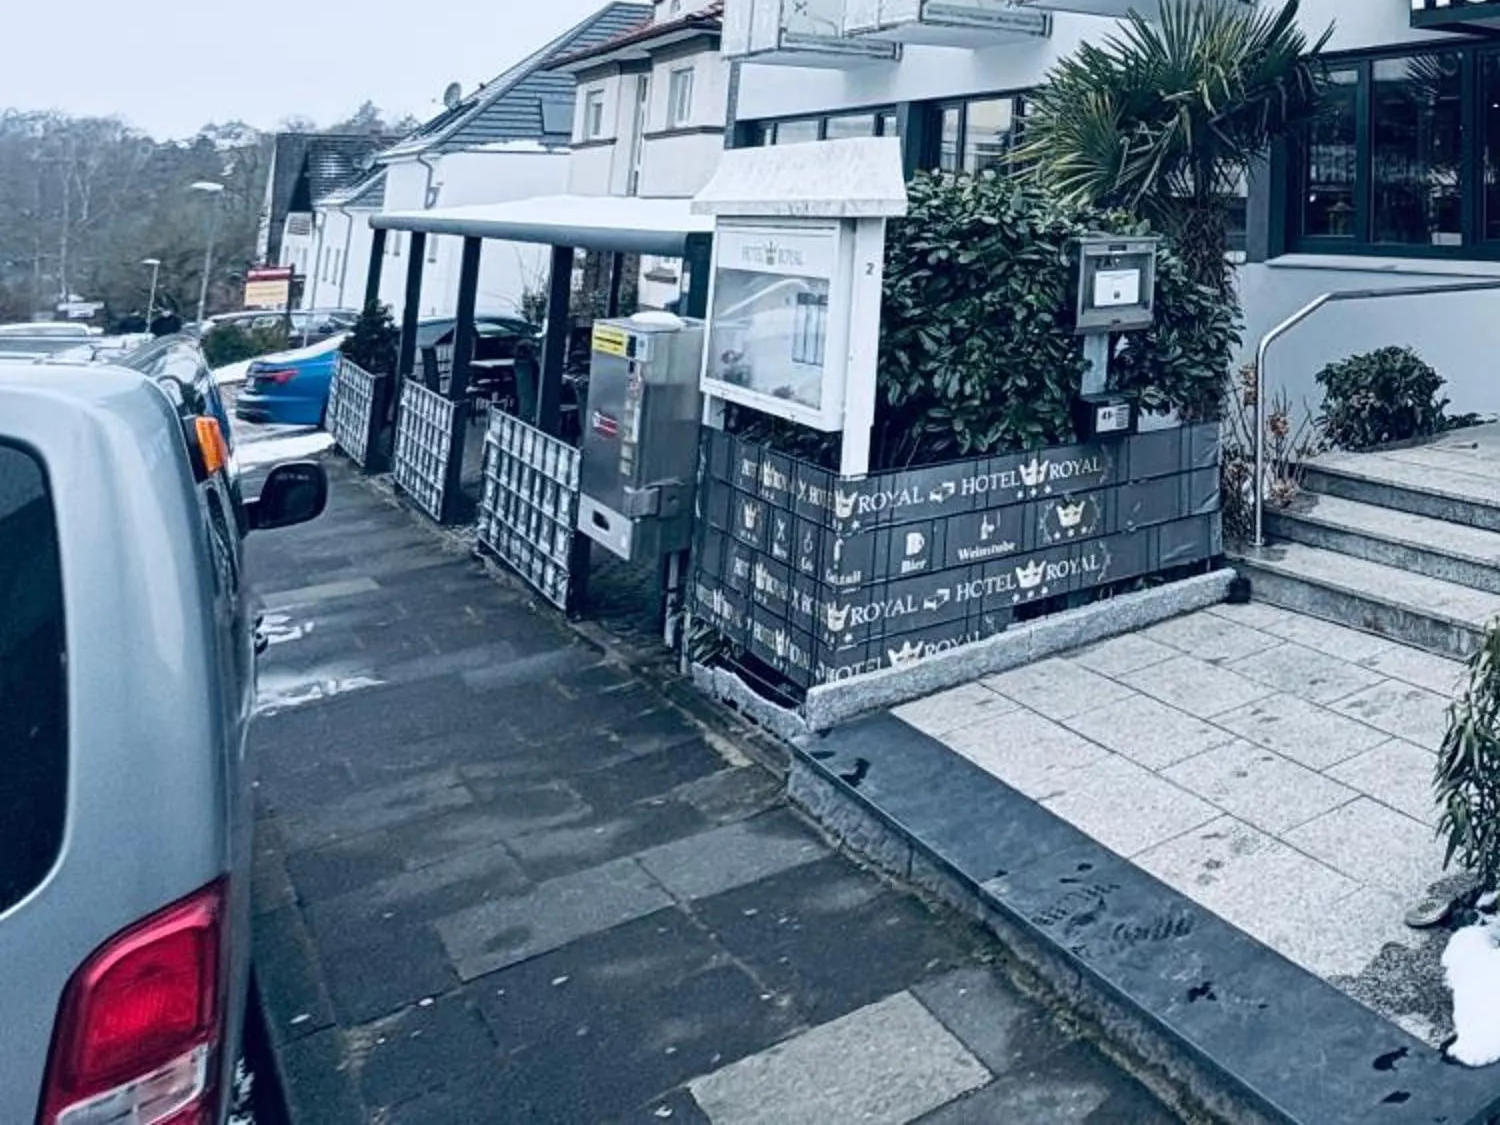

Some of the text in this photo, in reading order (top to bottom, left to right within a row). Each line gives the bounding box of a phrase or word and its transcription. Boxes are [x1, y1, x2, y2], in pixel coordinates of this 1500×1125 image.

[865, 262, 875, 275] 2
[857, 455, 1102, 515] ROYAL HOTEL ROYAL
[957, 540, 1016, 561] Weinstube
[901, 559, 927, 574] Bier
[849, 554, 1100, 627] ROYAL HOTEL ROYAL
